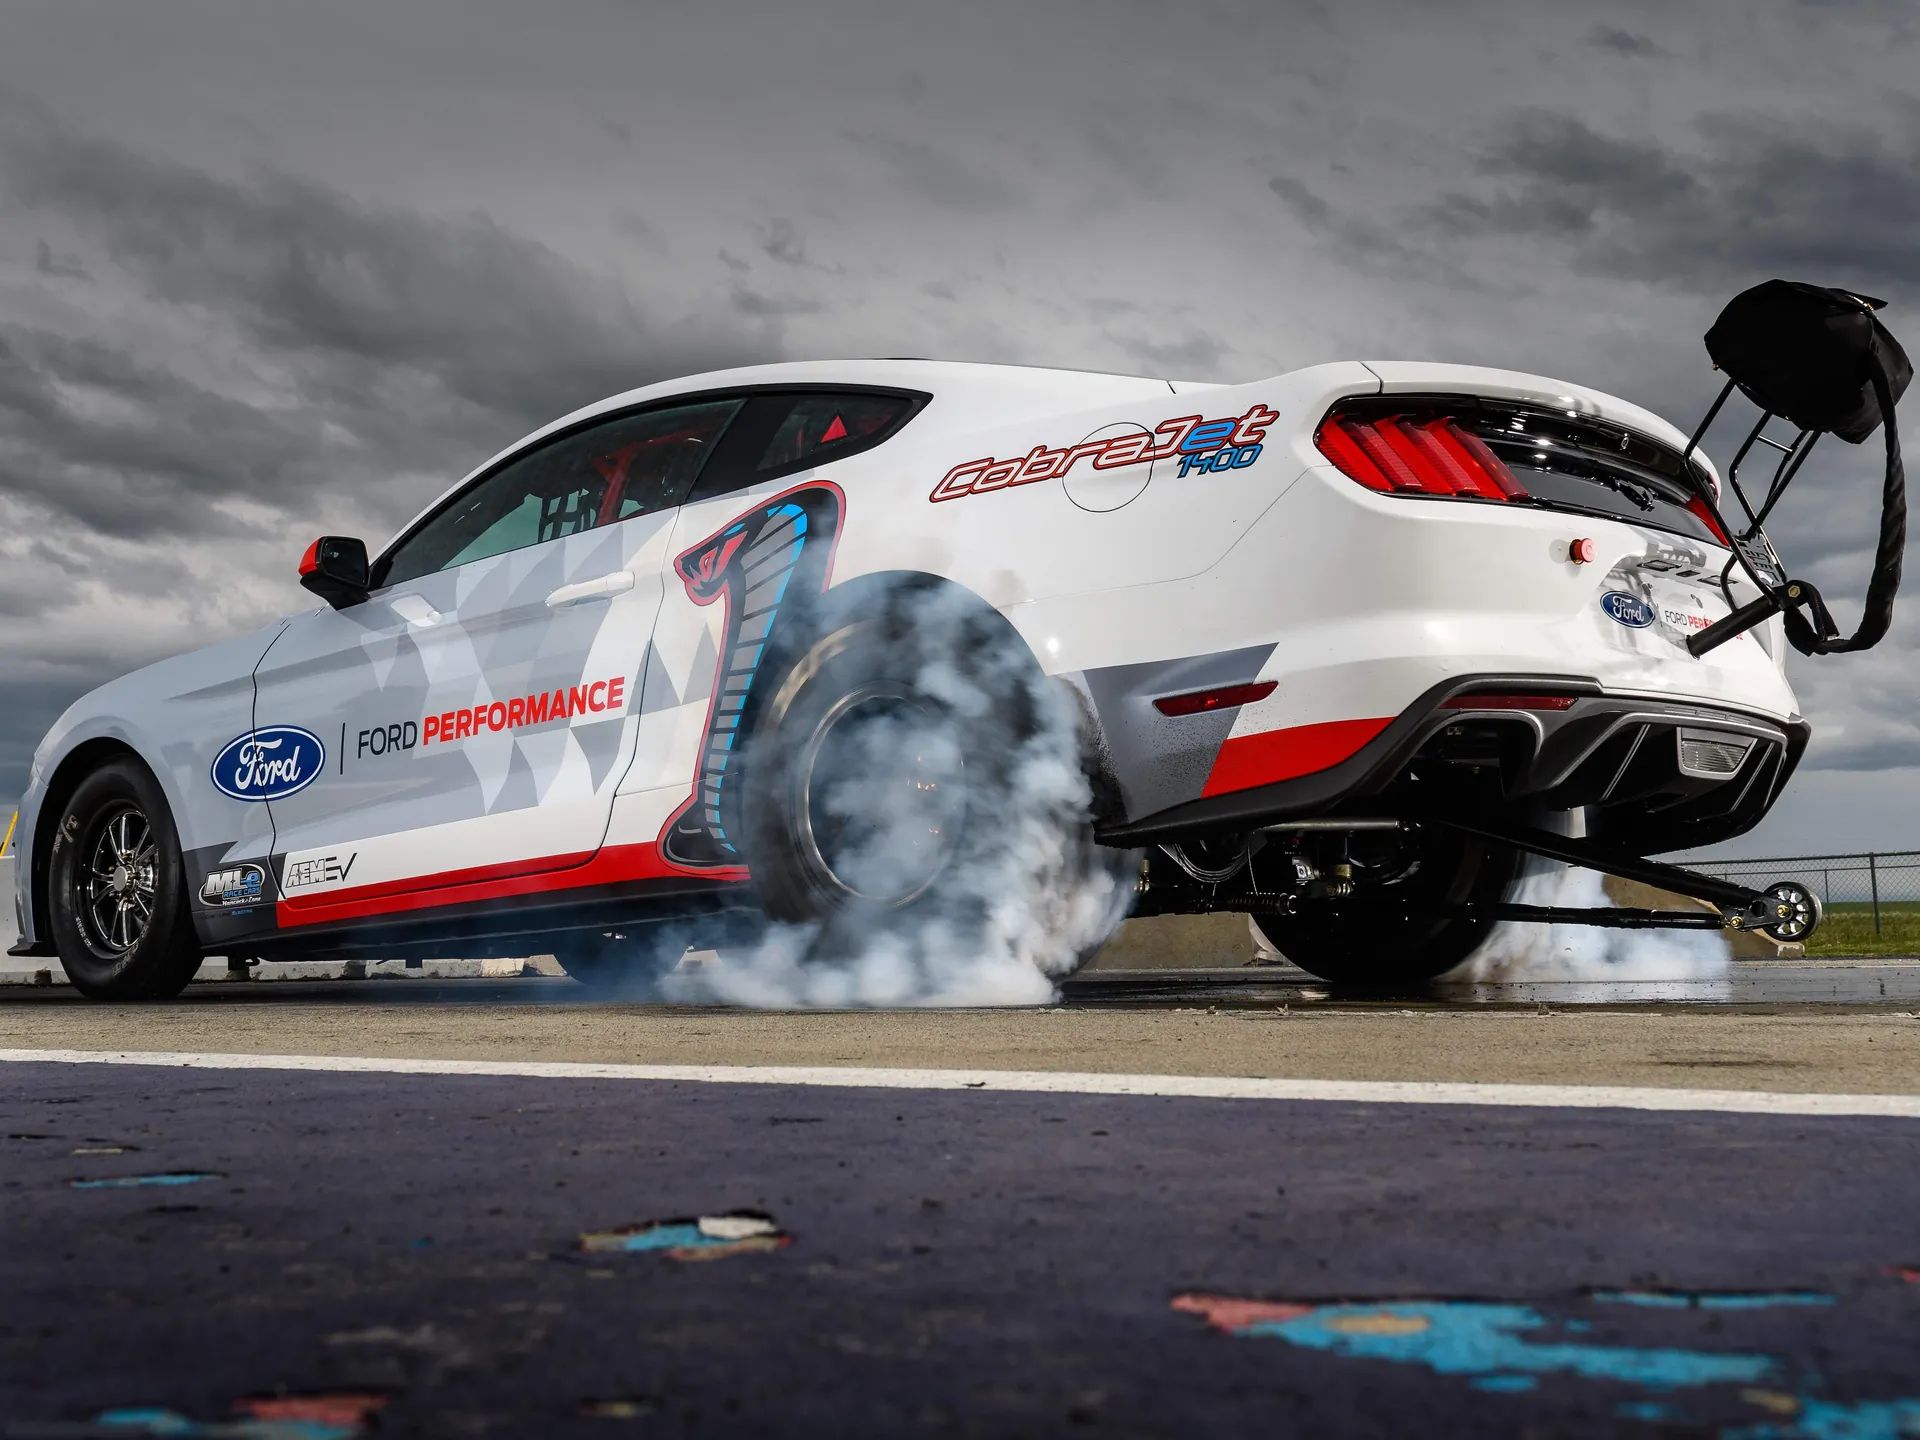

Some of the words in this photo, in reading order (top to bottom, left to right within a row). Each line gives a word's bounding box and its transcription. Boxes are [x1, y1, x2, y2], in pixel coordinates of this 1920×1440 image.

[929, 404, 1281, 503] CobraJet
[1176, 443, 1263, 479] 1400
[1612, 595, 1645, 622] Ford
[1664, 610, 1688, 626] FORD
[357, 720, 418, 759] FORD
[422, 676, 626, 746] PERFORMANCE
[234, 738, 301, 790] Ford
[223, 889, 243, 898] RACE
[243, 887, 261, 895] CARS
